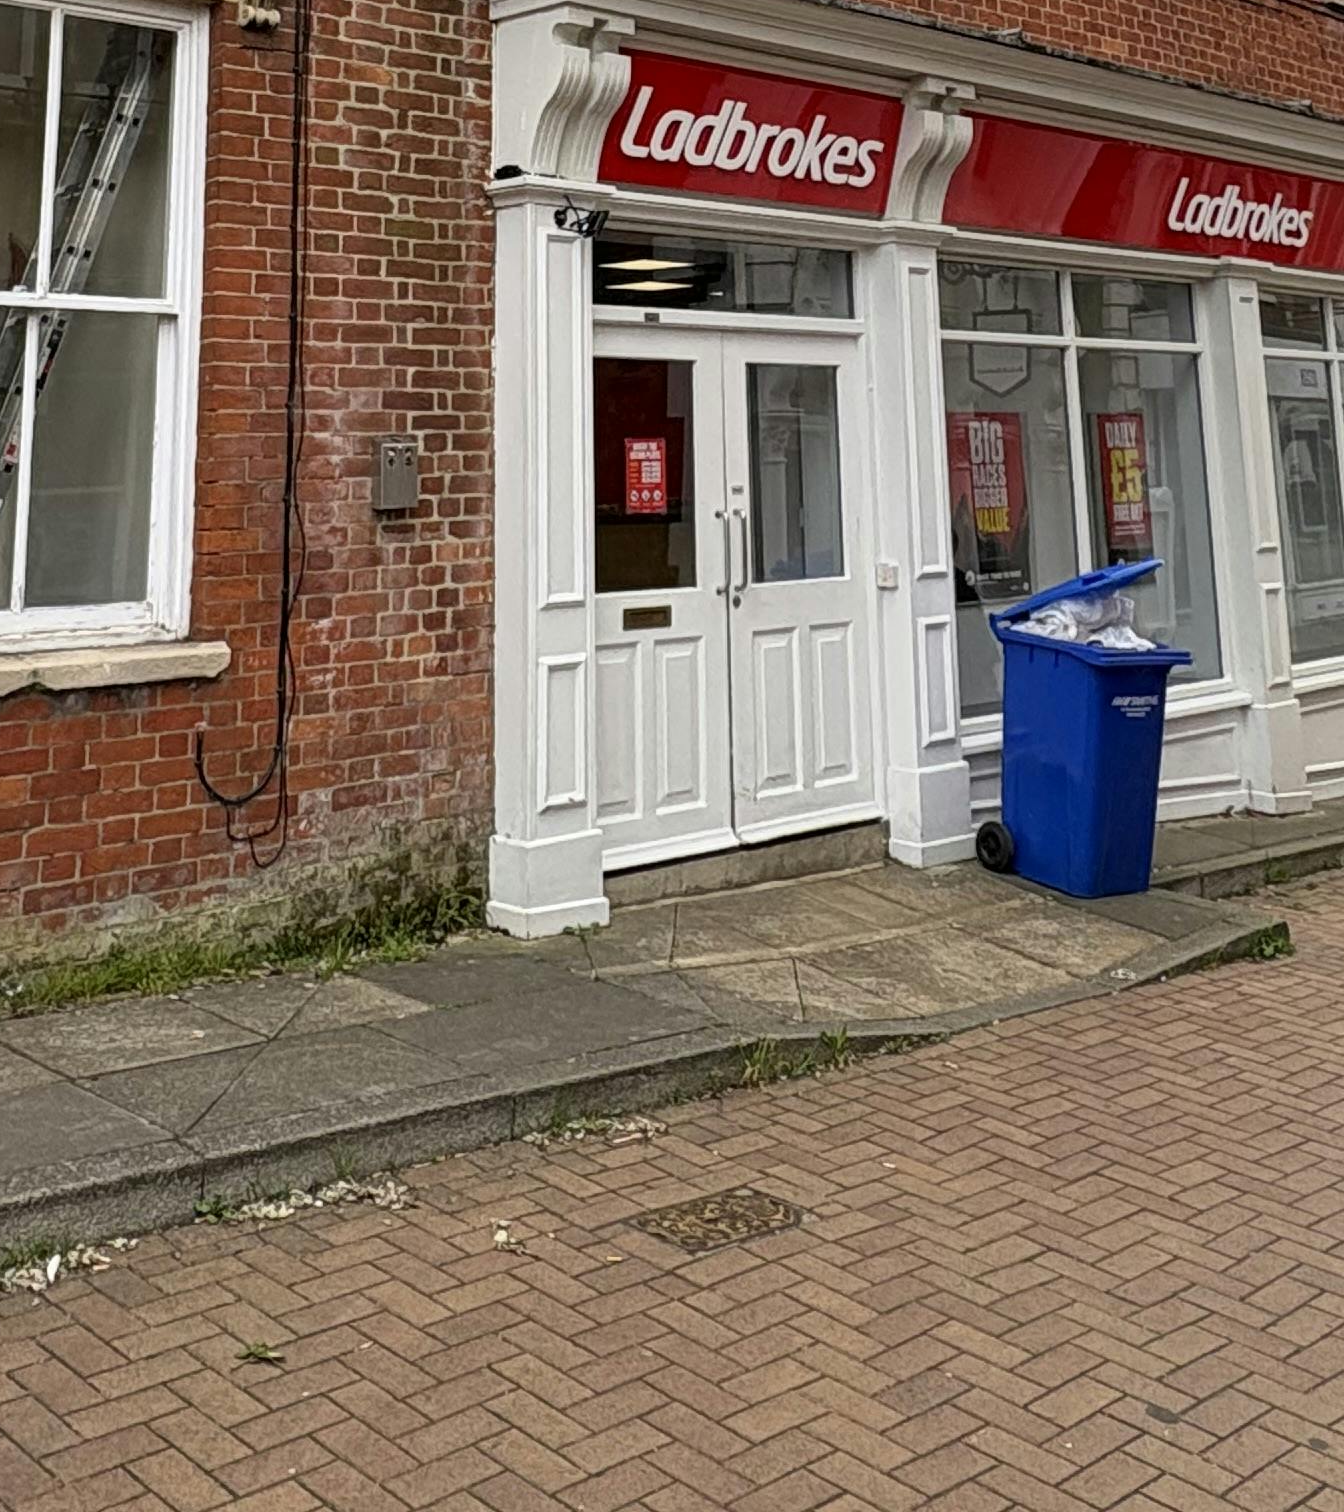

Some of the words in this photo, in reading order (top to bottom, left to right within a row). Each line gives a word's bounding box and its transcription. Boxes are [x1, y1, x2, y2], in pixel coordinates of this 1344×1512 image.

[620, 85, 885, 188] Ladbrokes
[1167, 177, 1314, 248] Ladbrokes
[968, 420, 1005, 464] BIG
[1110, 449, 1143, 502] £5
[975, 507, 1010, 533] VALUE
